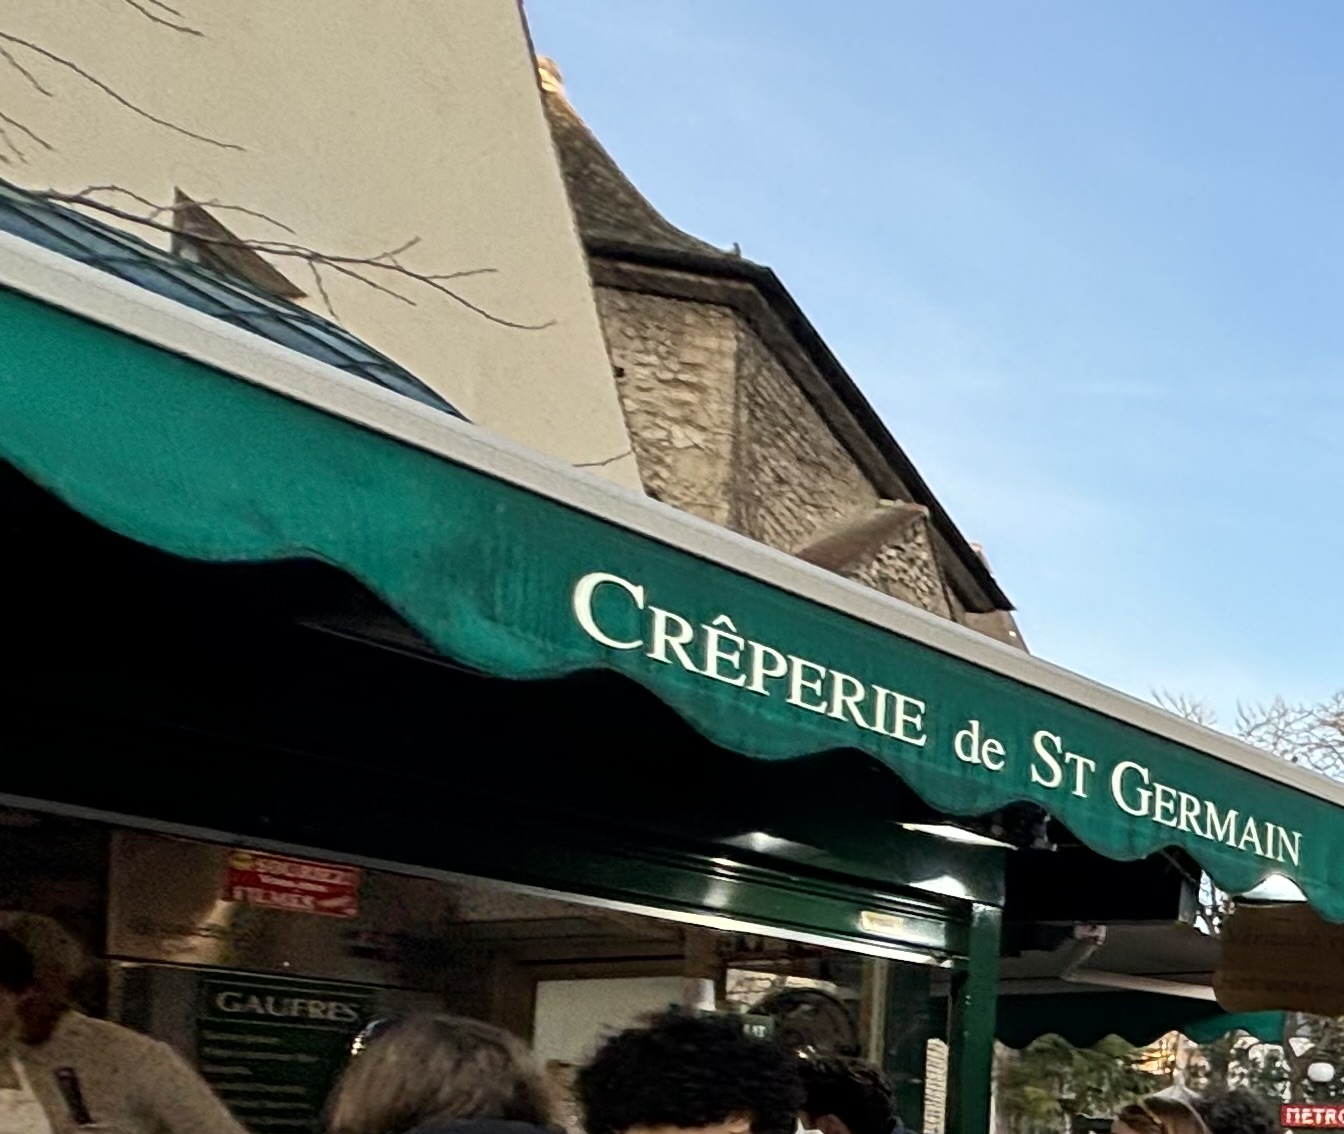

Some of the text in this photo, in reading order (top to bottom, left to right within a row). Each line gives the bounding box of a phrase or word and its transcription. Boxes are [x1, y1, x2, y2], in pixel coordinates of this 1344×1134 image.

[953, 718, 1007, 772] de
[1110, 759, 1303, 867] GERMAIN
[214, 990, 359, 1023] GAUFRES
